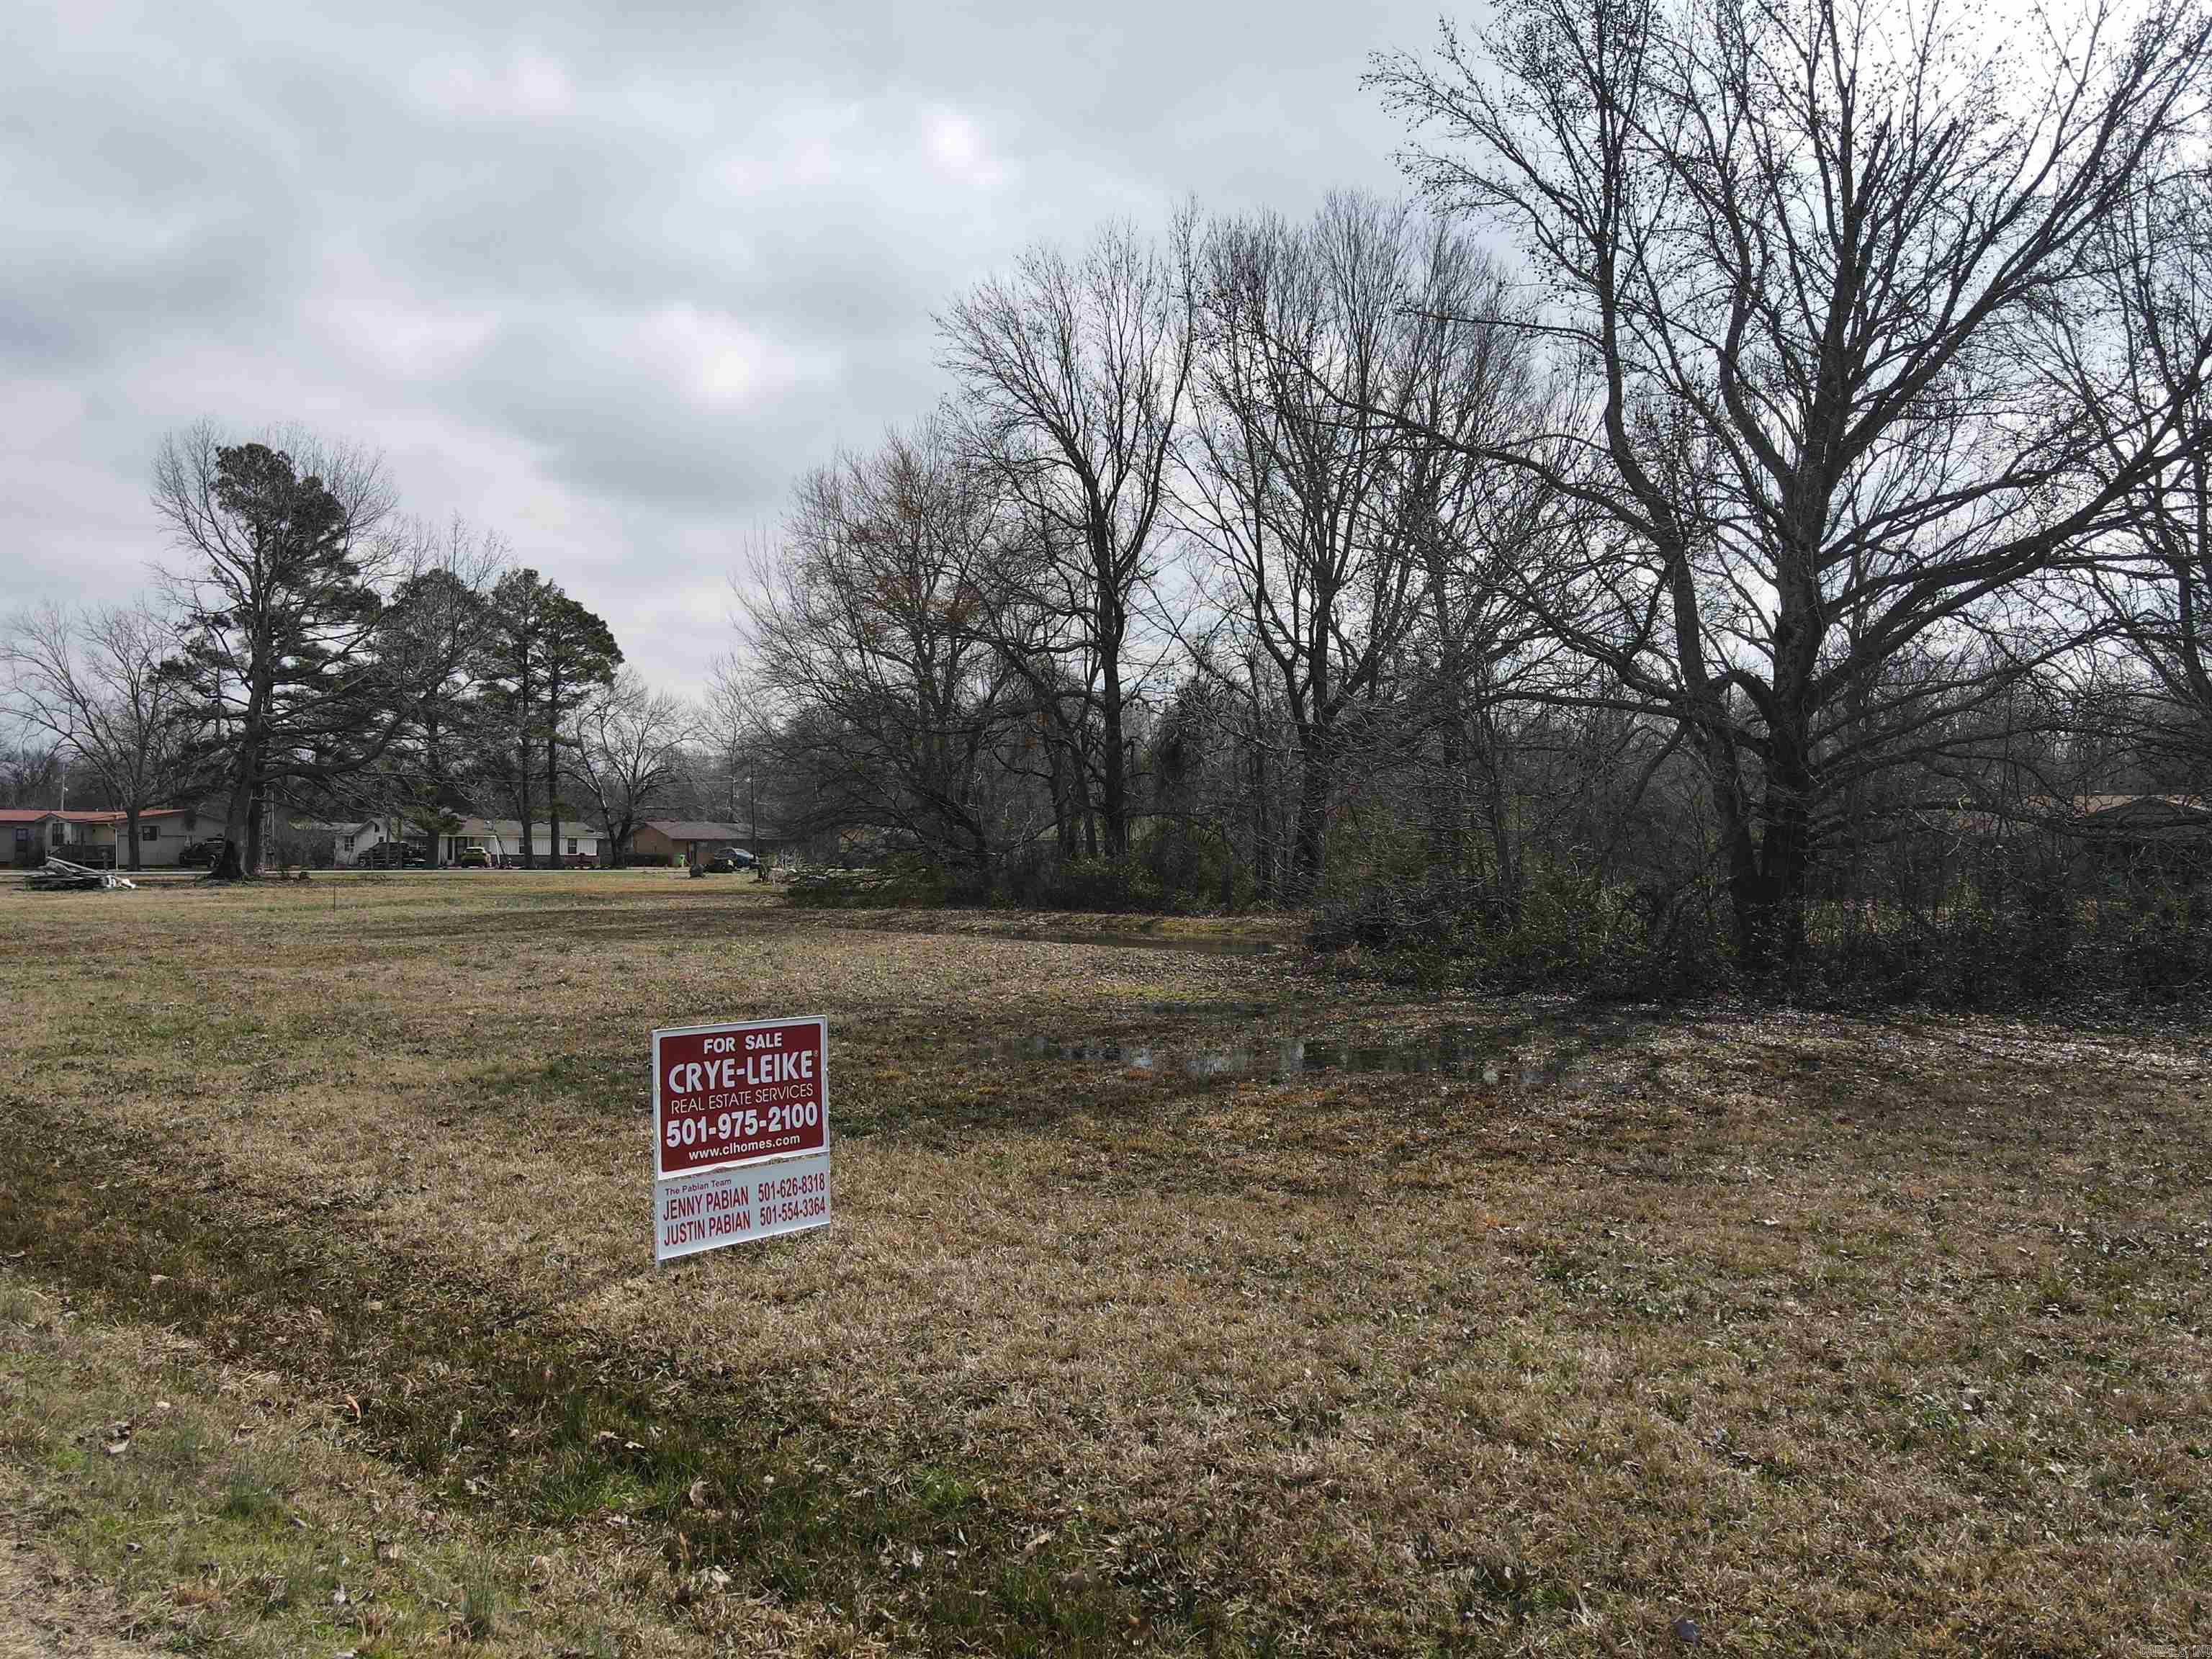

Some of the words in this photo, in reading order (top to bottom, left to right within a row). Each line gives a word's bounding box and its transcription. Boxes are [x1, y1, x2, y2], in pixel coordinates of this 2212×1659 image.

[703, 1037, 736, 1054] FOR
[745, 1033, 782, 1050] SALE
[668, 1050, 813, 1094] CRYE-LEIKE
[671, 1100, 705, 1114] REAL
[709, 1090, 751, 1110] ESTATE
[755, 1083, 813, 1102] SERVICES
[666, 1101, 817, 1147] 501-975-2100
[688, 1135, 800, 1160] www.clhomes.com
[663, 1194, 703, 1220] JENNY
[706, 1186, 748, 1213] PABIAN
[758, 1172, 825, 1202] 501-626-8318
[682, 1183, 709, 1192] Pabian
[664, 1218, 705, 1246] JUSTIN
[709, 1210, 750, 1237] PABIAN
[760, 1195, 826, 1226] 501-554-3364
